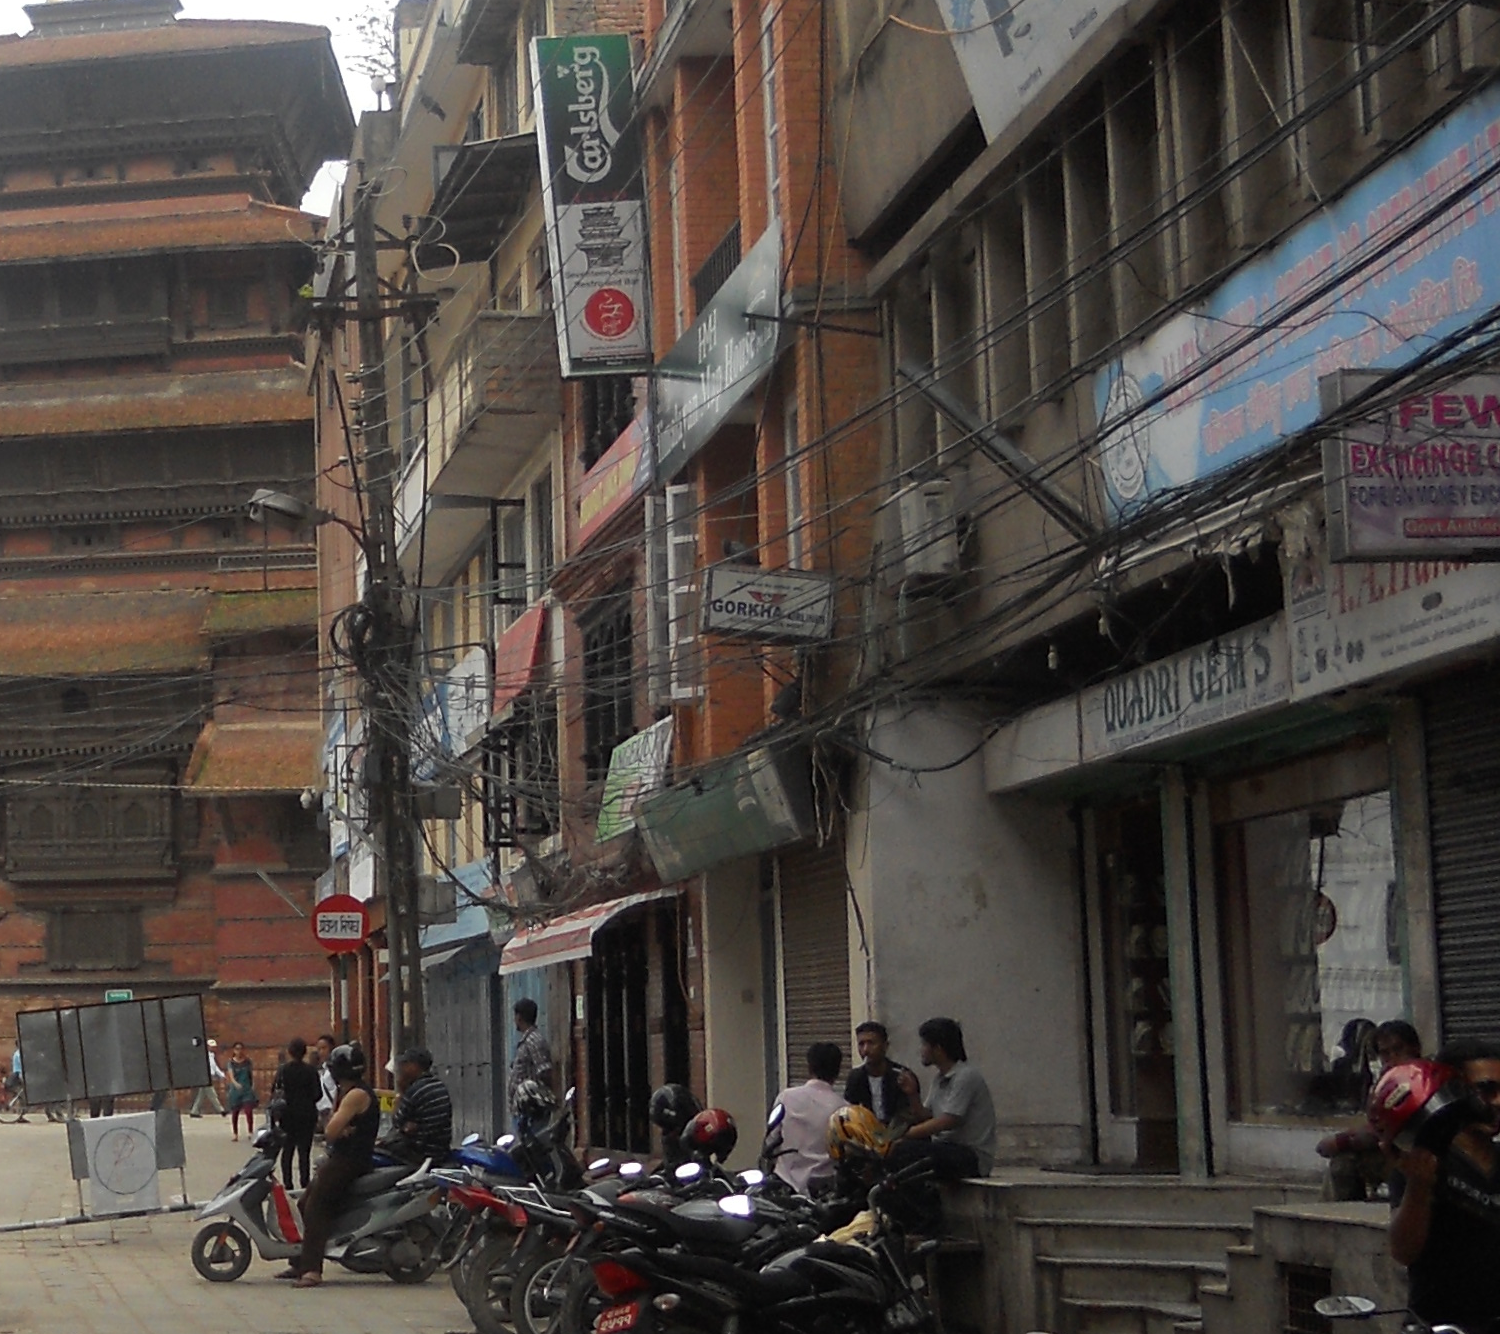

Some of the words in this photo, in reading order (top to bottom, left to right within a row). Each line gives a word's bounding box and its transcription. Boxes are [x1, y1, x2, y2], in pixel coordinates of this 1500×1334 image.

[563, 46, 620, 184] Carlsberg
[712, 599, 781, 618] GORKHA
[1104, 660, 1181, 733] QUADRI
